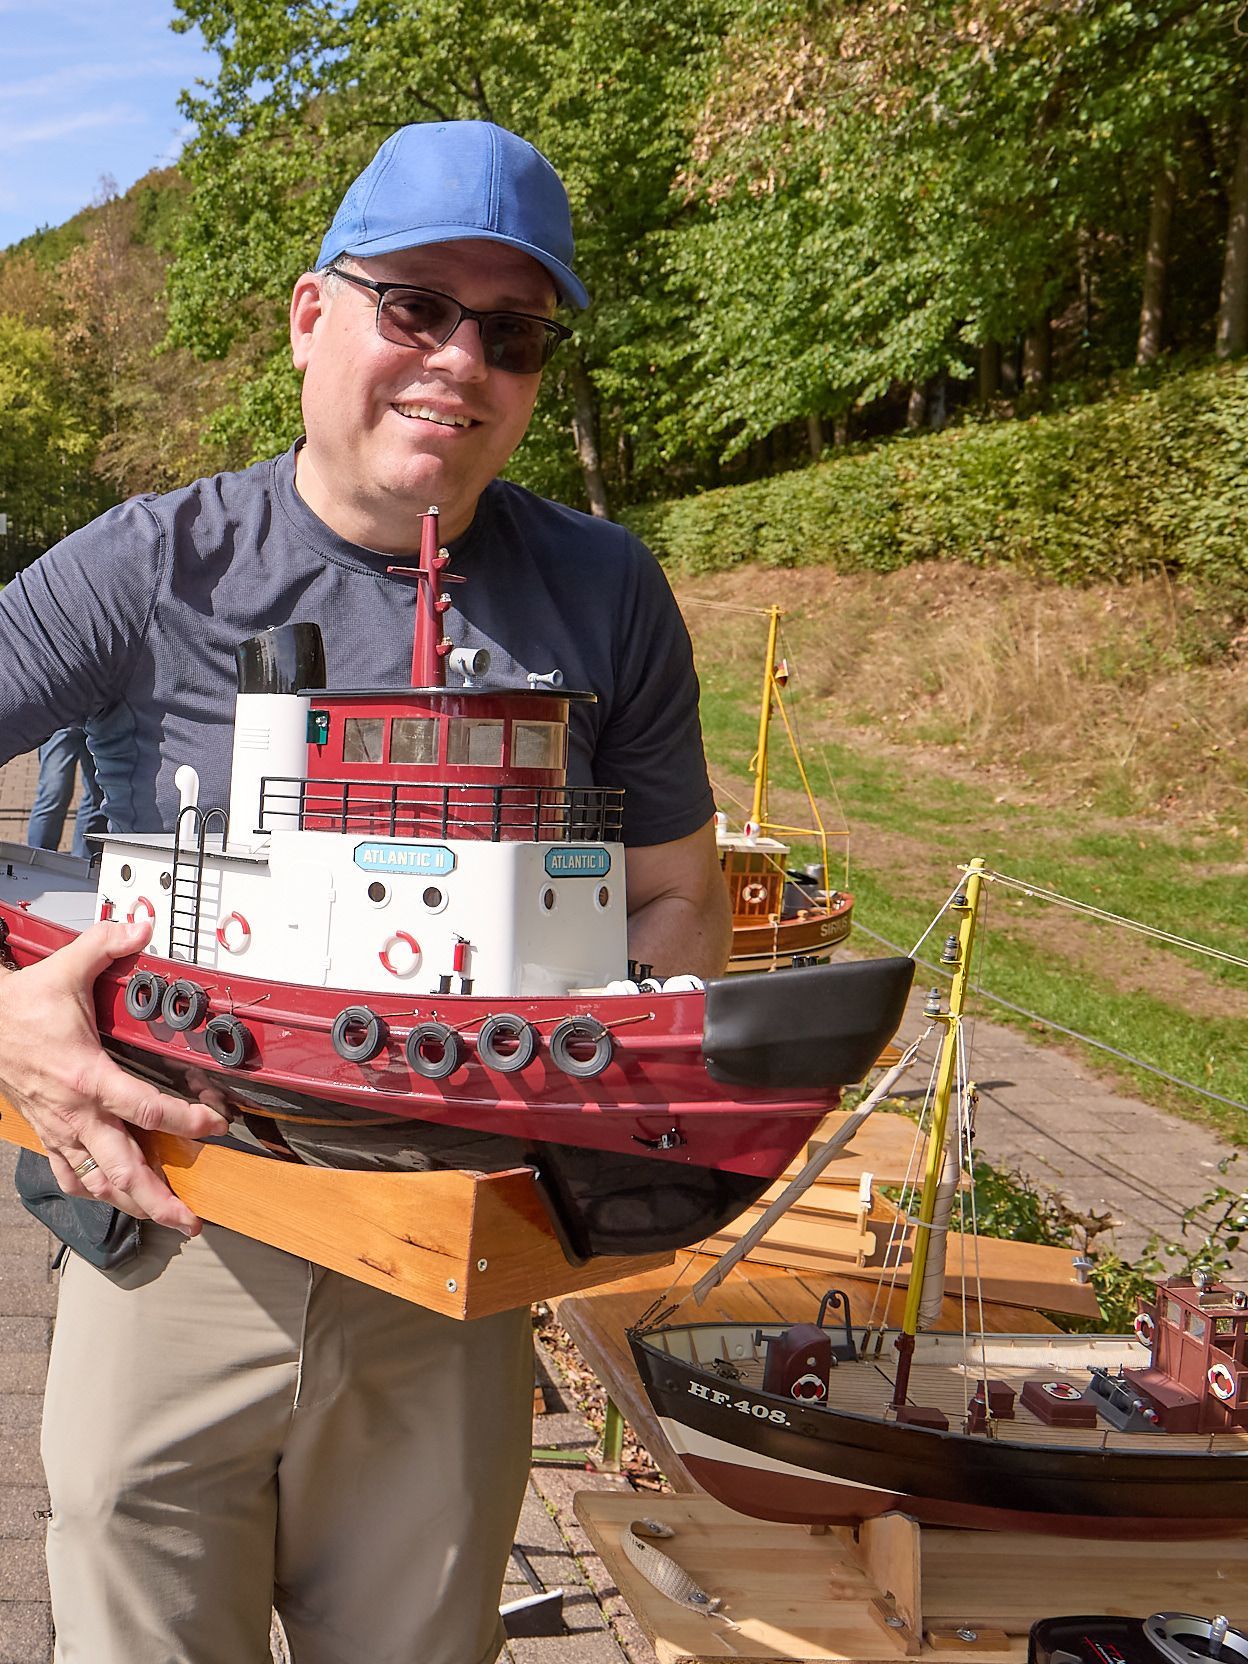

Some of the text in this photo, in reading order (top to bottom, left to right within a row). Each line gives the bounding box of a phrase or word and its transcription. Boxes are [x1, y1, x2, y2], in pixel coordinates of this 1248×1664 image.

[362, 848, 445, 869] ATLANTIC II
[551, 855, 604, 869] ATLANTIC II
